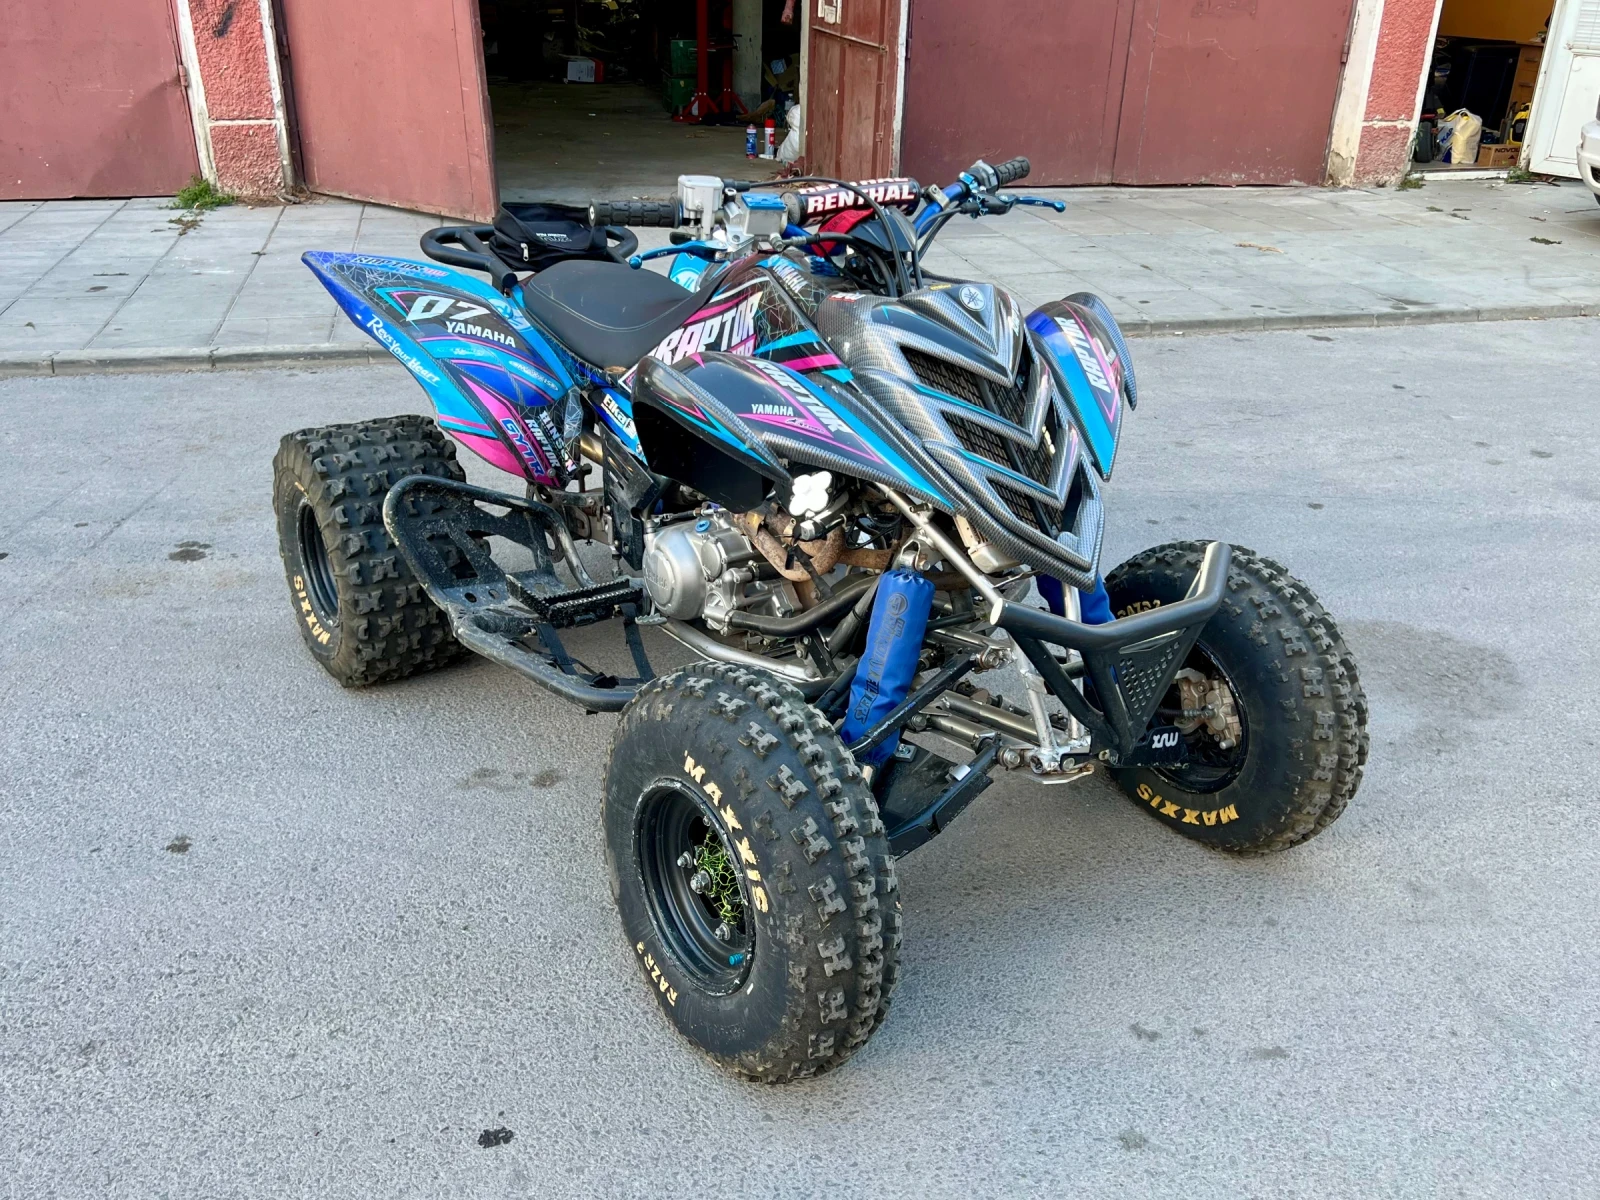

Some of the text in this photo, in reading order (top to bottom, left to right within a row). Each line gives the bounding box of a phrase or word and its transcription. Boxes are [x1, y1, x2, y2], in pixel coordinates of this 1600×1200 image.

[807, 184, 915, 214] RENTHAL
[406, 295, 491, 321] 07
[655, 292, 763, 366] RAPTOR
[445, 321, 516, 348] YAMAHA
[1054, 286, 1111, 394] RAPTOR
[602, 393, 628, 426] Elka
[746, 359, 855, 434] RAPTOR
[751, 403, 794, 416] YAMAHA
[500, 418, 545, 476] GYTR
[525, 419, 560, 468] RAPTOR
[293, 575, 331, 645] MAXXIS
[1137, 784, 1239, 826] MAXXIS
[684, 750, 768, 913] MAXXIS
[644, 953, 678, 1007] RAZR
